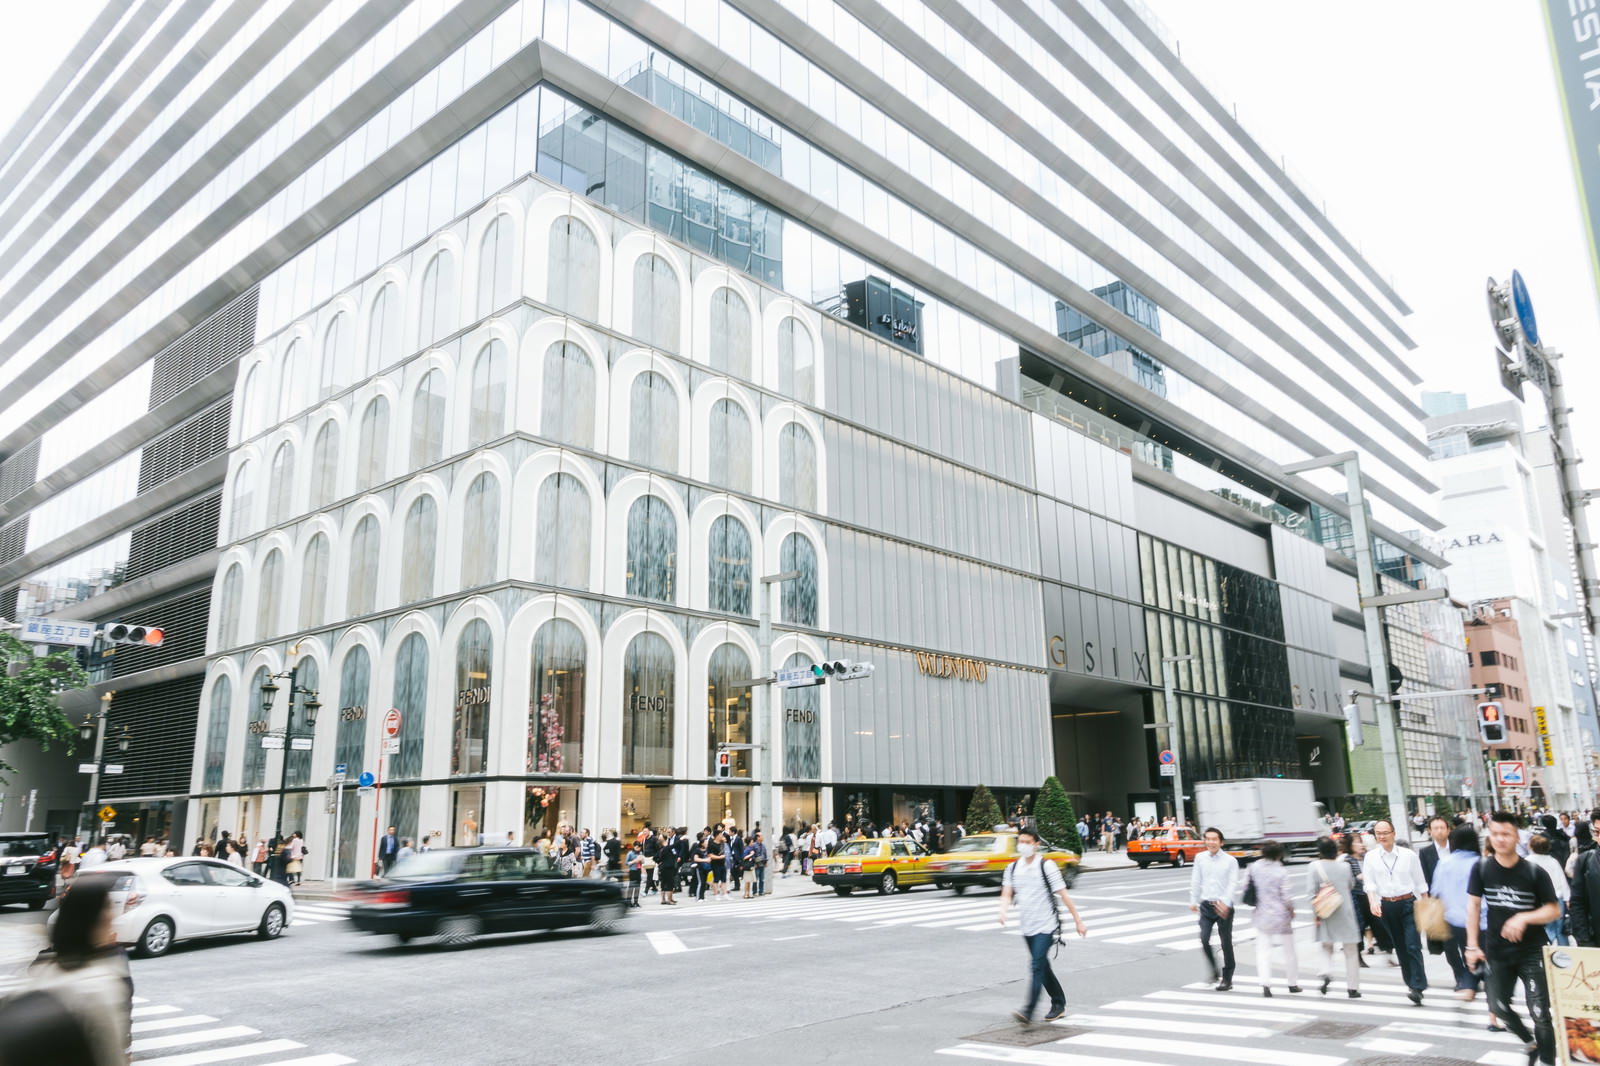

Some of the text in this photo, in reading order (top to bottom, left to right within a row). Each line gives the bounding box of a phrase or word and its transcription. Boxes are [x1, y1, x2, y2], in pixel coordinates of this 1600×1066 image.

[1440, 532, 1504, 551] ARA
[916, 652, 986, 683] VALENTINO
[458, 686, 491, 706] FENDI
[629, 694, 668, 712] FENDI
[786, 709, 816, 723] FENDI
